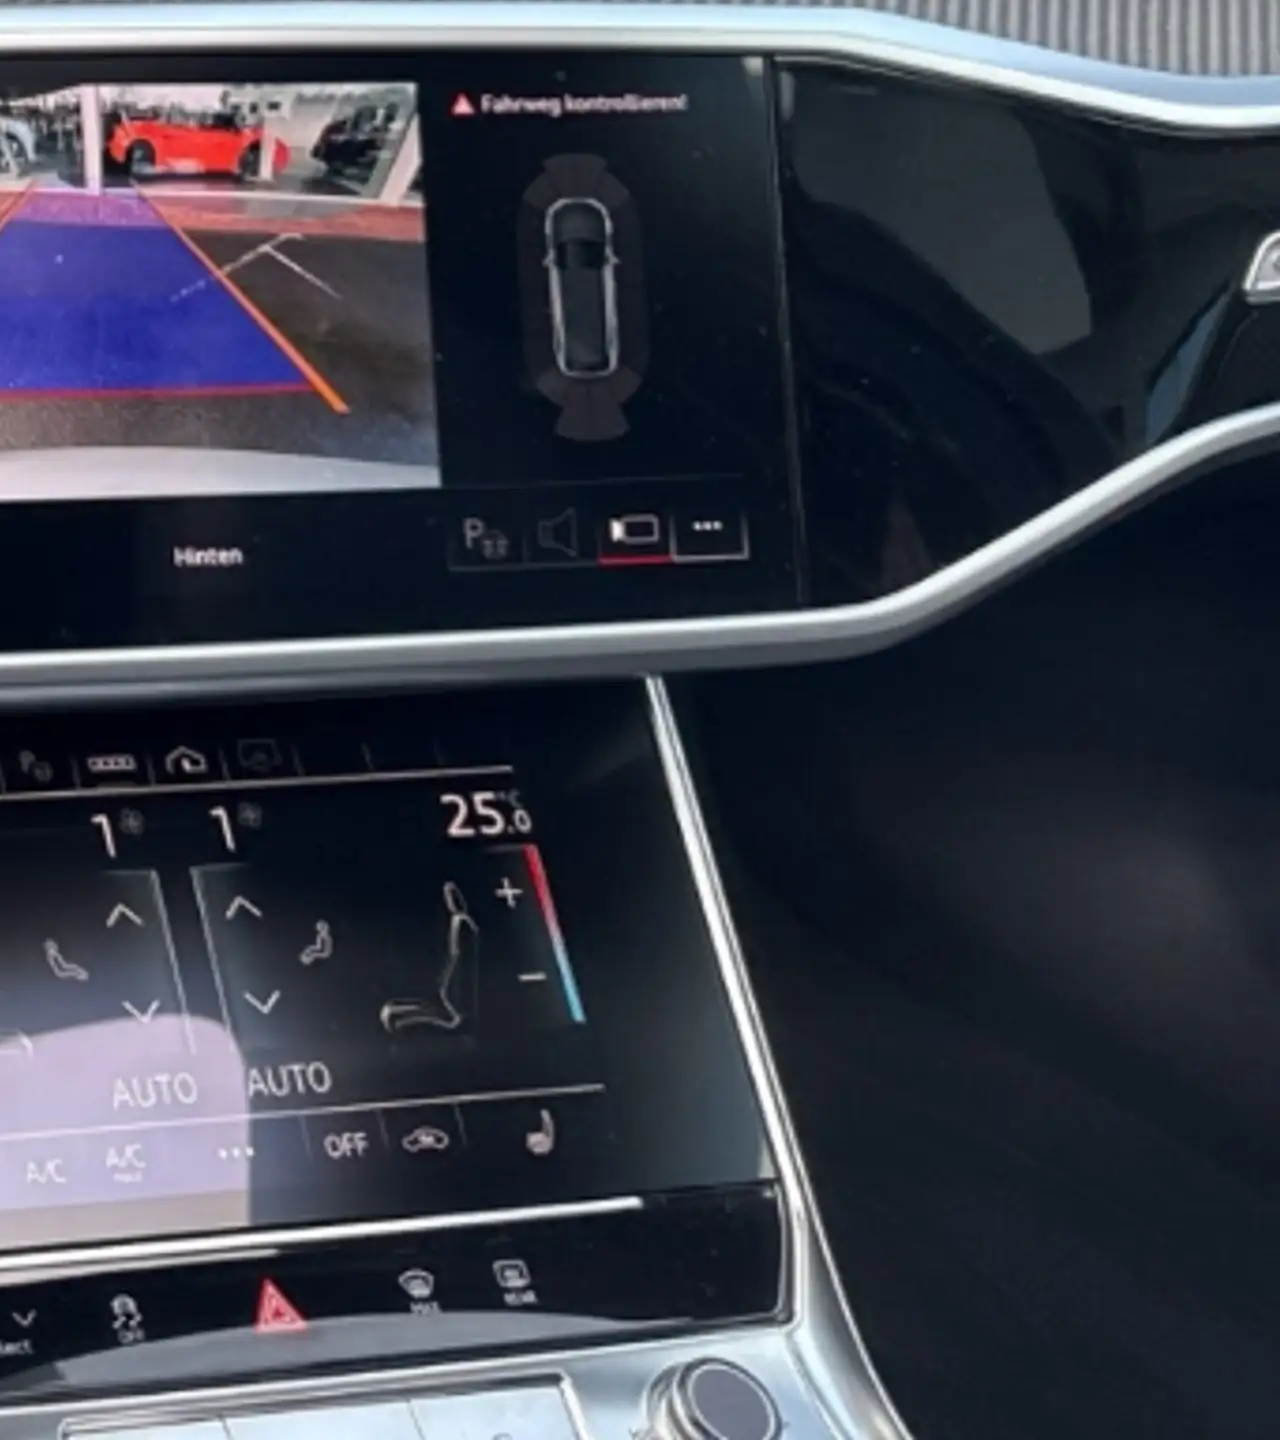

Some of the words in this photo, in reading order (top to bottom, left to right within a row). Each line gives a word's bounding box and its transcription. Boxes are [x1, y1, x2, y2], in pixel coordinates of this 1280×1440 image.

[480, 94, 561, 117] Fahrweg
[173, 545, 244, 567] Hinten
[247, 1061, 334, 1095] AUTO
[112, 1072, 199, 1111] AUTO
[323, 1133, 370, 1158] OFF
[26, 1158, 66, 1184] A/C
